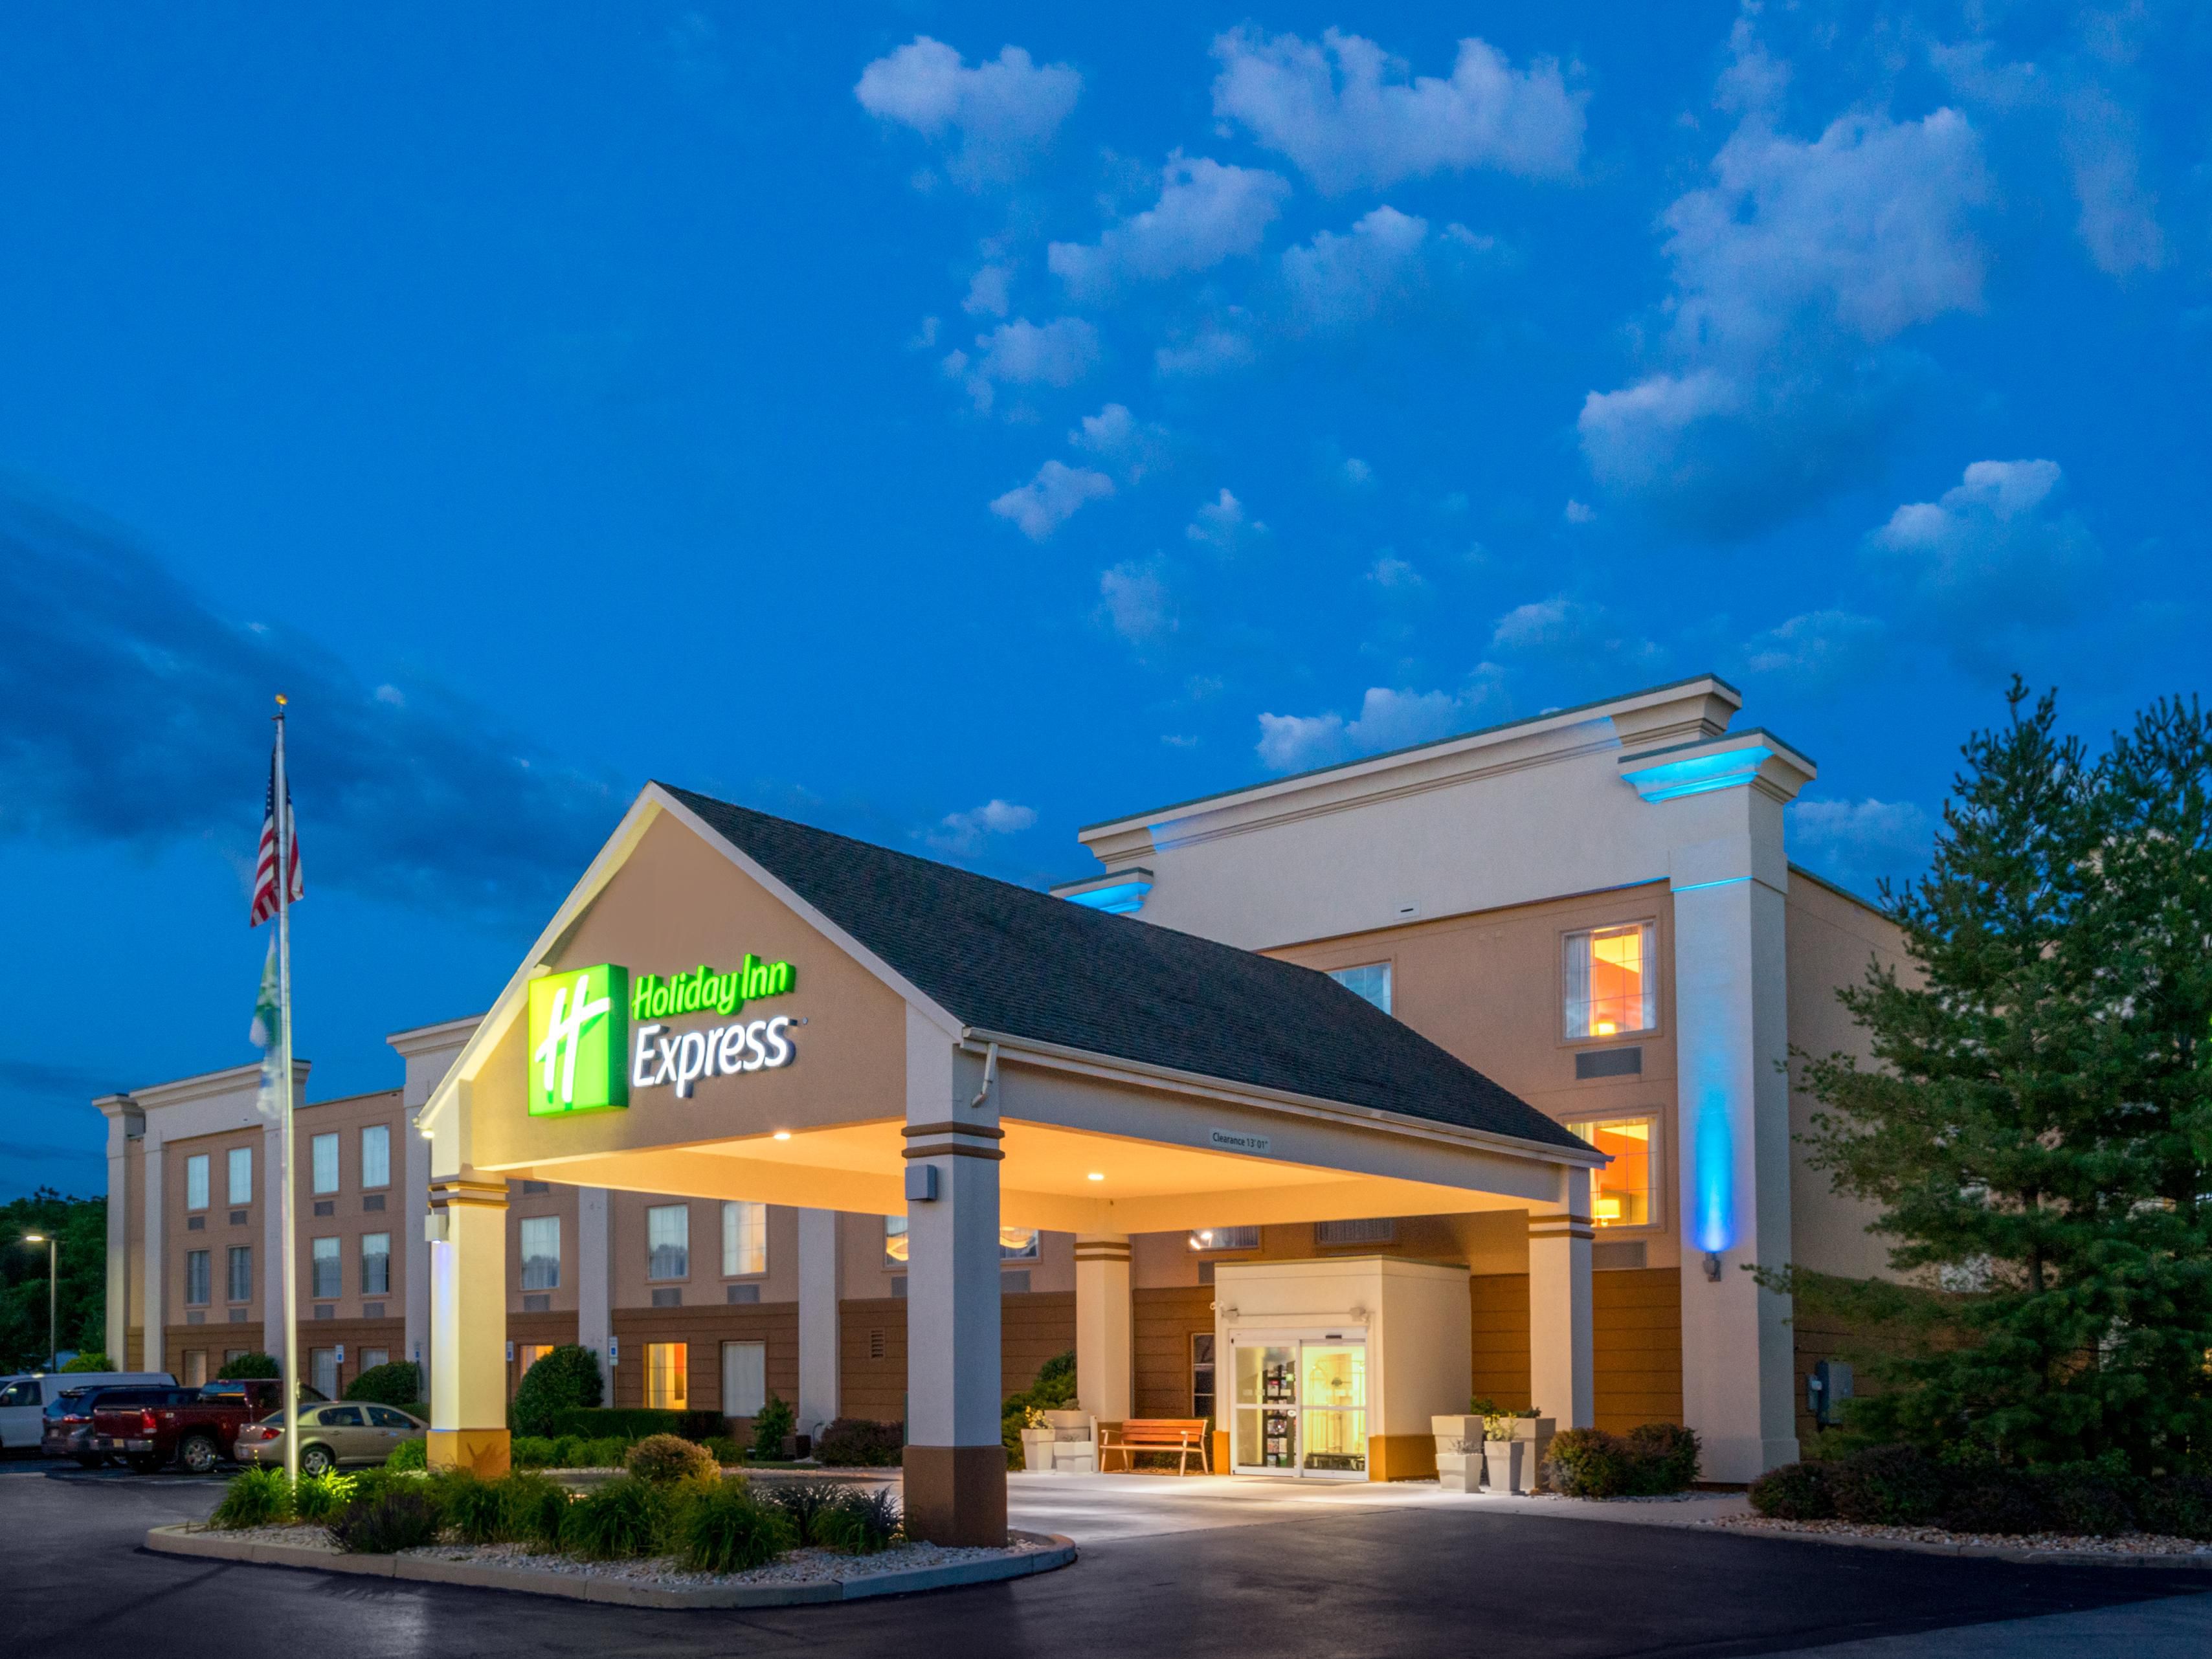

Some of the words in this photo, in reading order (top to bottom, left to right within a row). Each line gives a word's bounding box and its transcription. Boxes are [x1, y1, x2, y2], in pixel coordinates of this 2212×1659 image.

[632, 964, 741, 1020] Holiday
[741, 953, 794, 999] Inn
[632, 1016, 791, 1098] Express
[1212, 1132, 1245, 1146] Clearance
